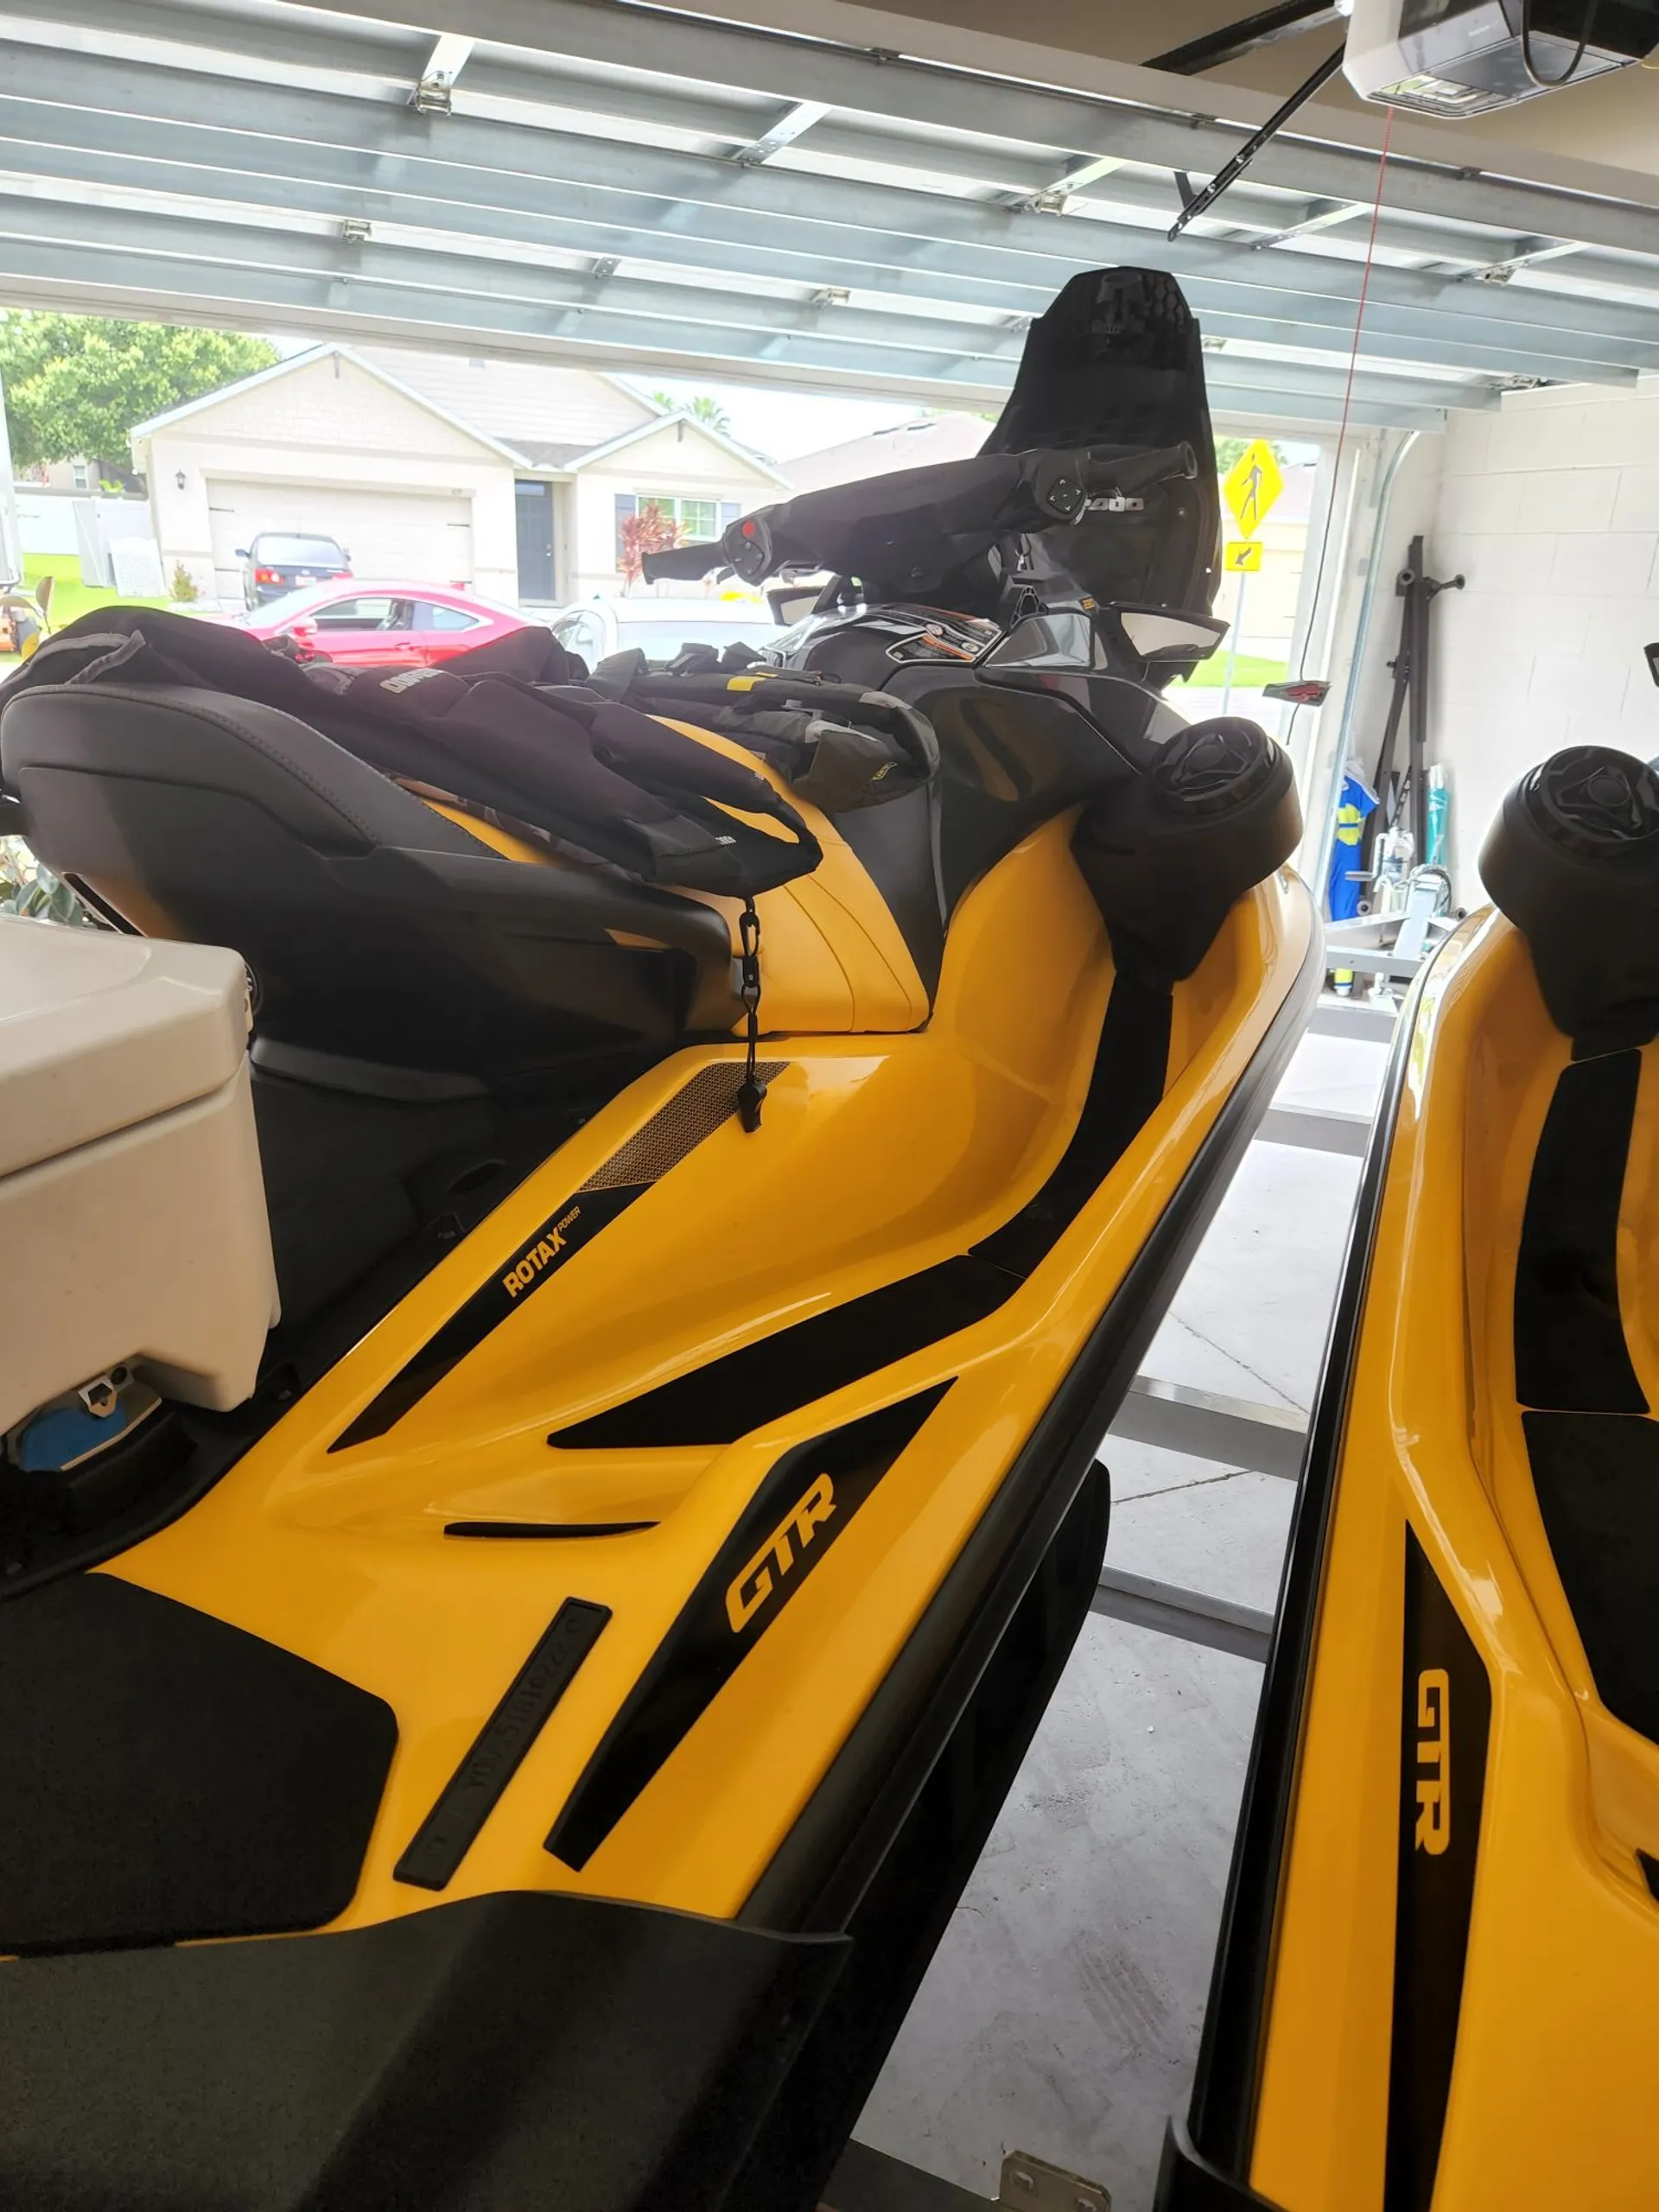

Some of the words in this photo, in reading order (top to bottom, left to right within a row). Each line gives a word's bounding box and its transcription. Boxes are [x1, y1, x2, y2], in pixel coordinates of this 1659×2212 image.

[503, 1226, 568, 1298] ROTAX
[556, 1205, 582, 1232] POWER
[726, 1472, 836, 1633] GTR
[1415, 1669, 1450, 1855] GTR
